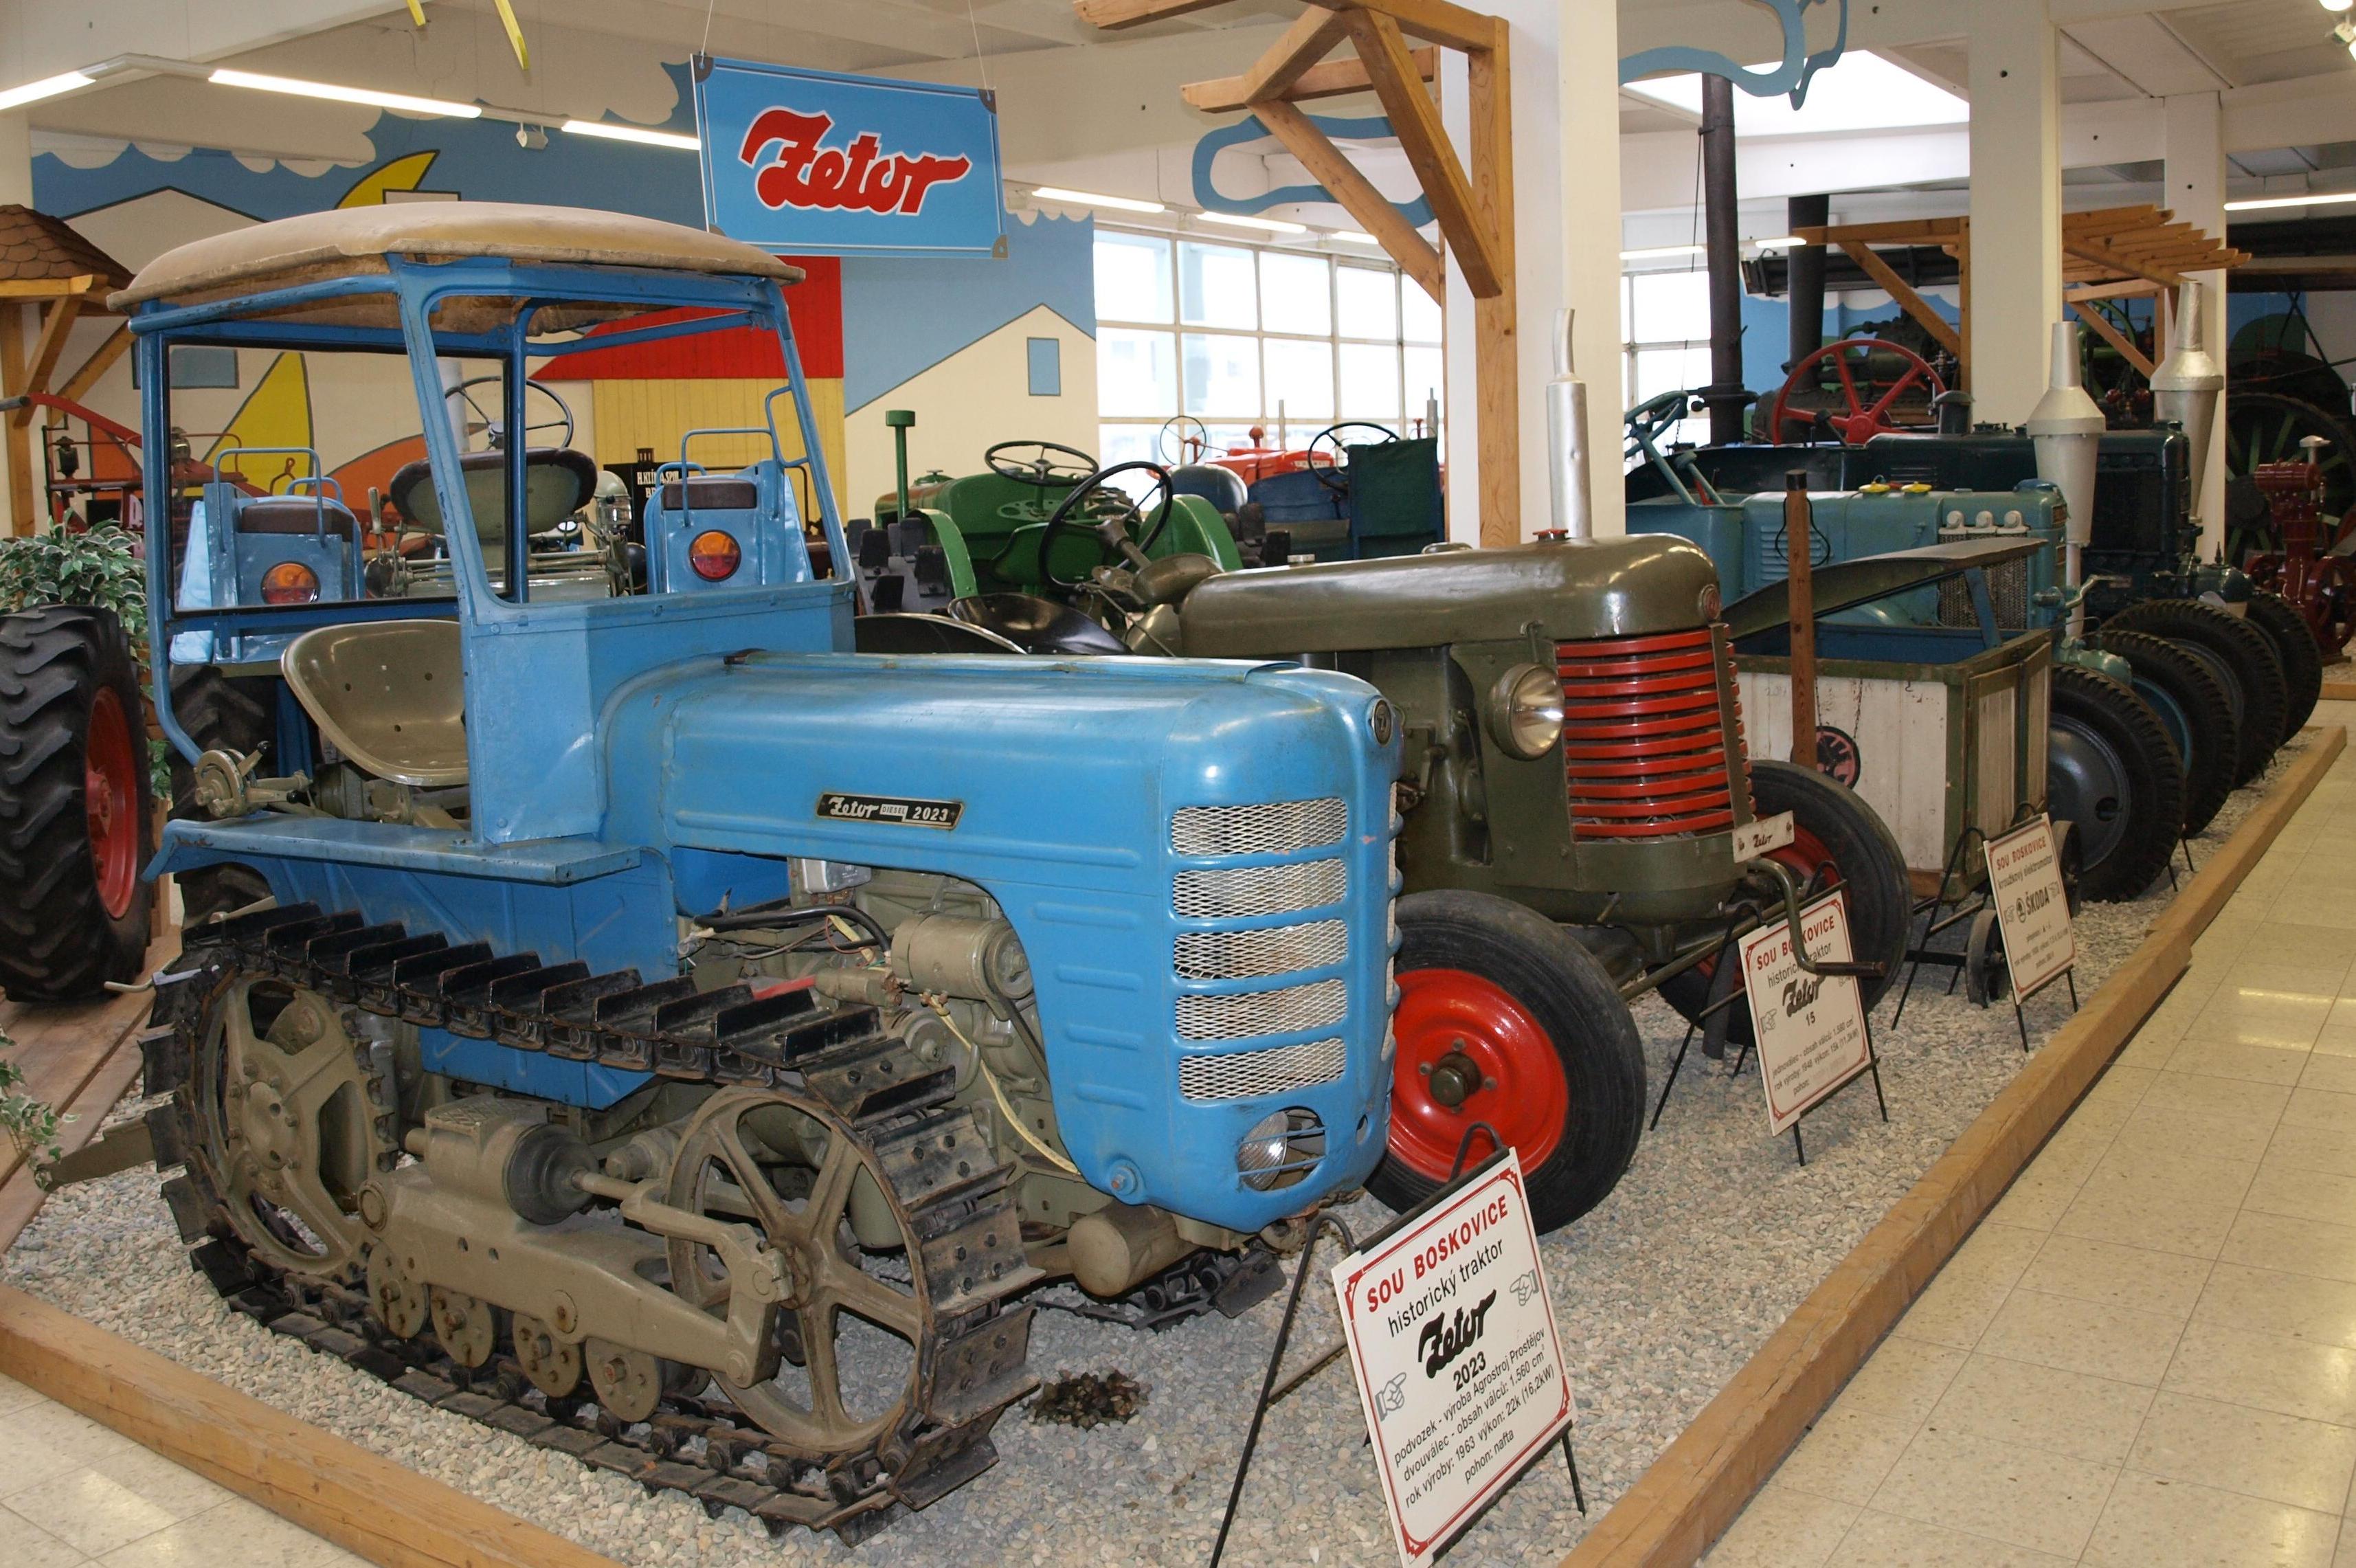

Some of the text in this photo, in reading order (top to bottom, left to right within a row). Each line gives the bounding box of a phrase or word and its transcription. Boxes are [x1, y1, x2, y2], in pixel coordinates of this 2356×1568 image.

[739, 107, 972, 214] Zetor
[828, 796, 950, 821] Zetor DIESEL 2023
[1997, 836, 2046, 871] SOU BOSKOVICE
[2026, 886, 2050, 915] ŠKODA
[1757, 948, 1776, 970] SOU
[1782, 974, 1827, 1017] Zetor
[1806, 1011, 1815, 1026] 15
[1367, 1195, 1507, 1312] SOU BOSKOVICE
[1388, 1239, 1502, 1337] historický traktor
[1418, 1289, 1496, 1378] Zetor
[1395, 1420, 1437, 1468] podvozek
[1444, 1391, 1472, 1421] výroba
[1474, 1356, 1510, 1396] Agrostroj
[1510, 1328, 1544, 1364] Prostějov
[1454, 1352, 1485, 1391] 2023
[1404, 1436, 1449, 1481] dvouválec
[1457, 1404, 1483, 1433] obsah
[1484, 1382, 1508, 1409] válců:
[1510, 1361, 1530, 1386] 1.560
[1406, 1364, 1554, 1508] rok výroby: 1963 výkon: 22k (16,2kW)
[1465, 1430, 1514, 1484] pohon: nafta
